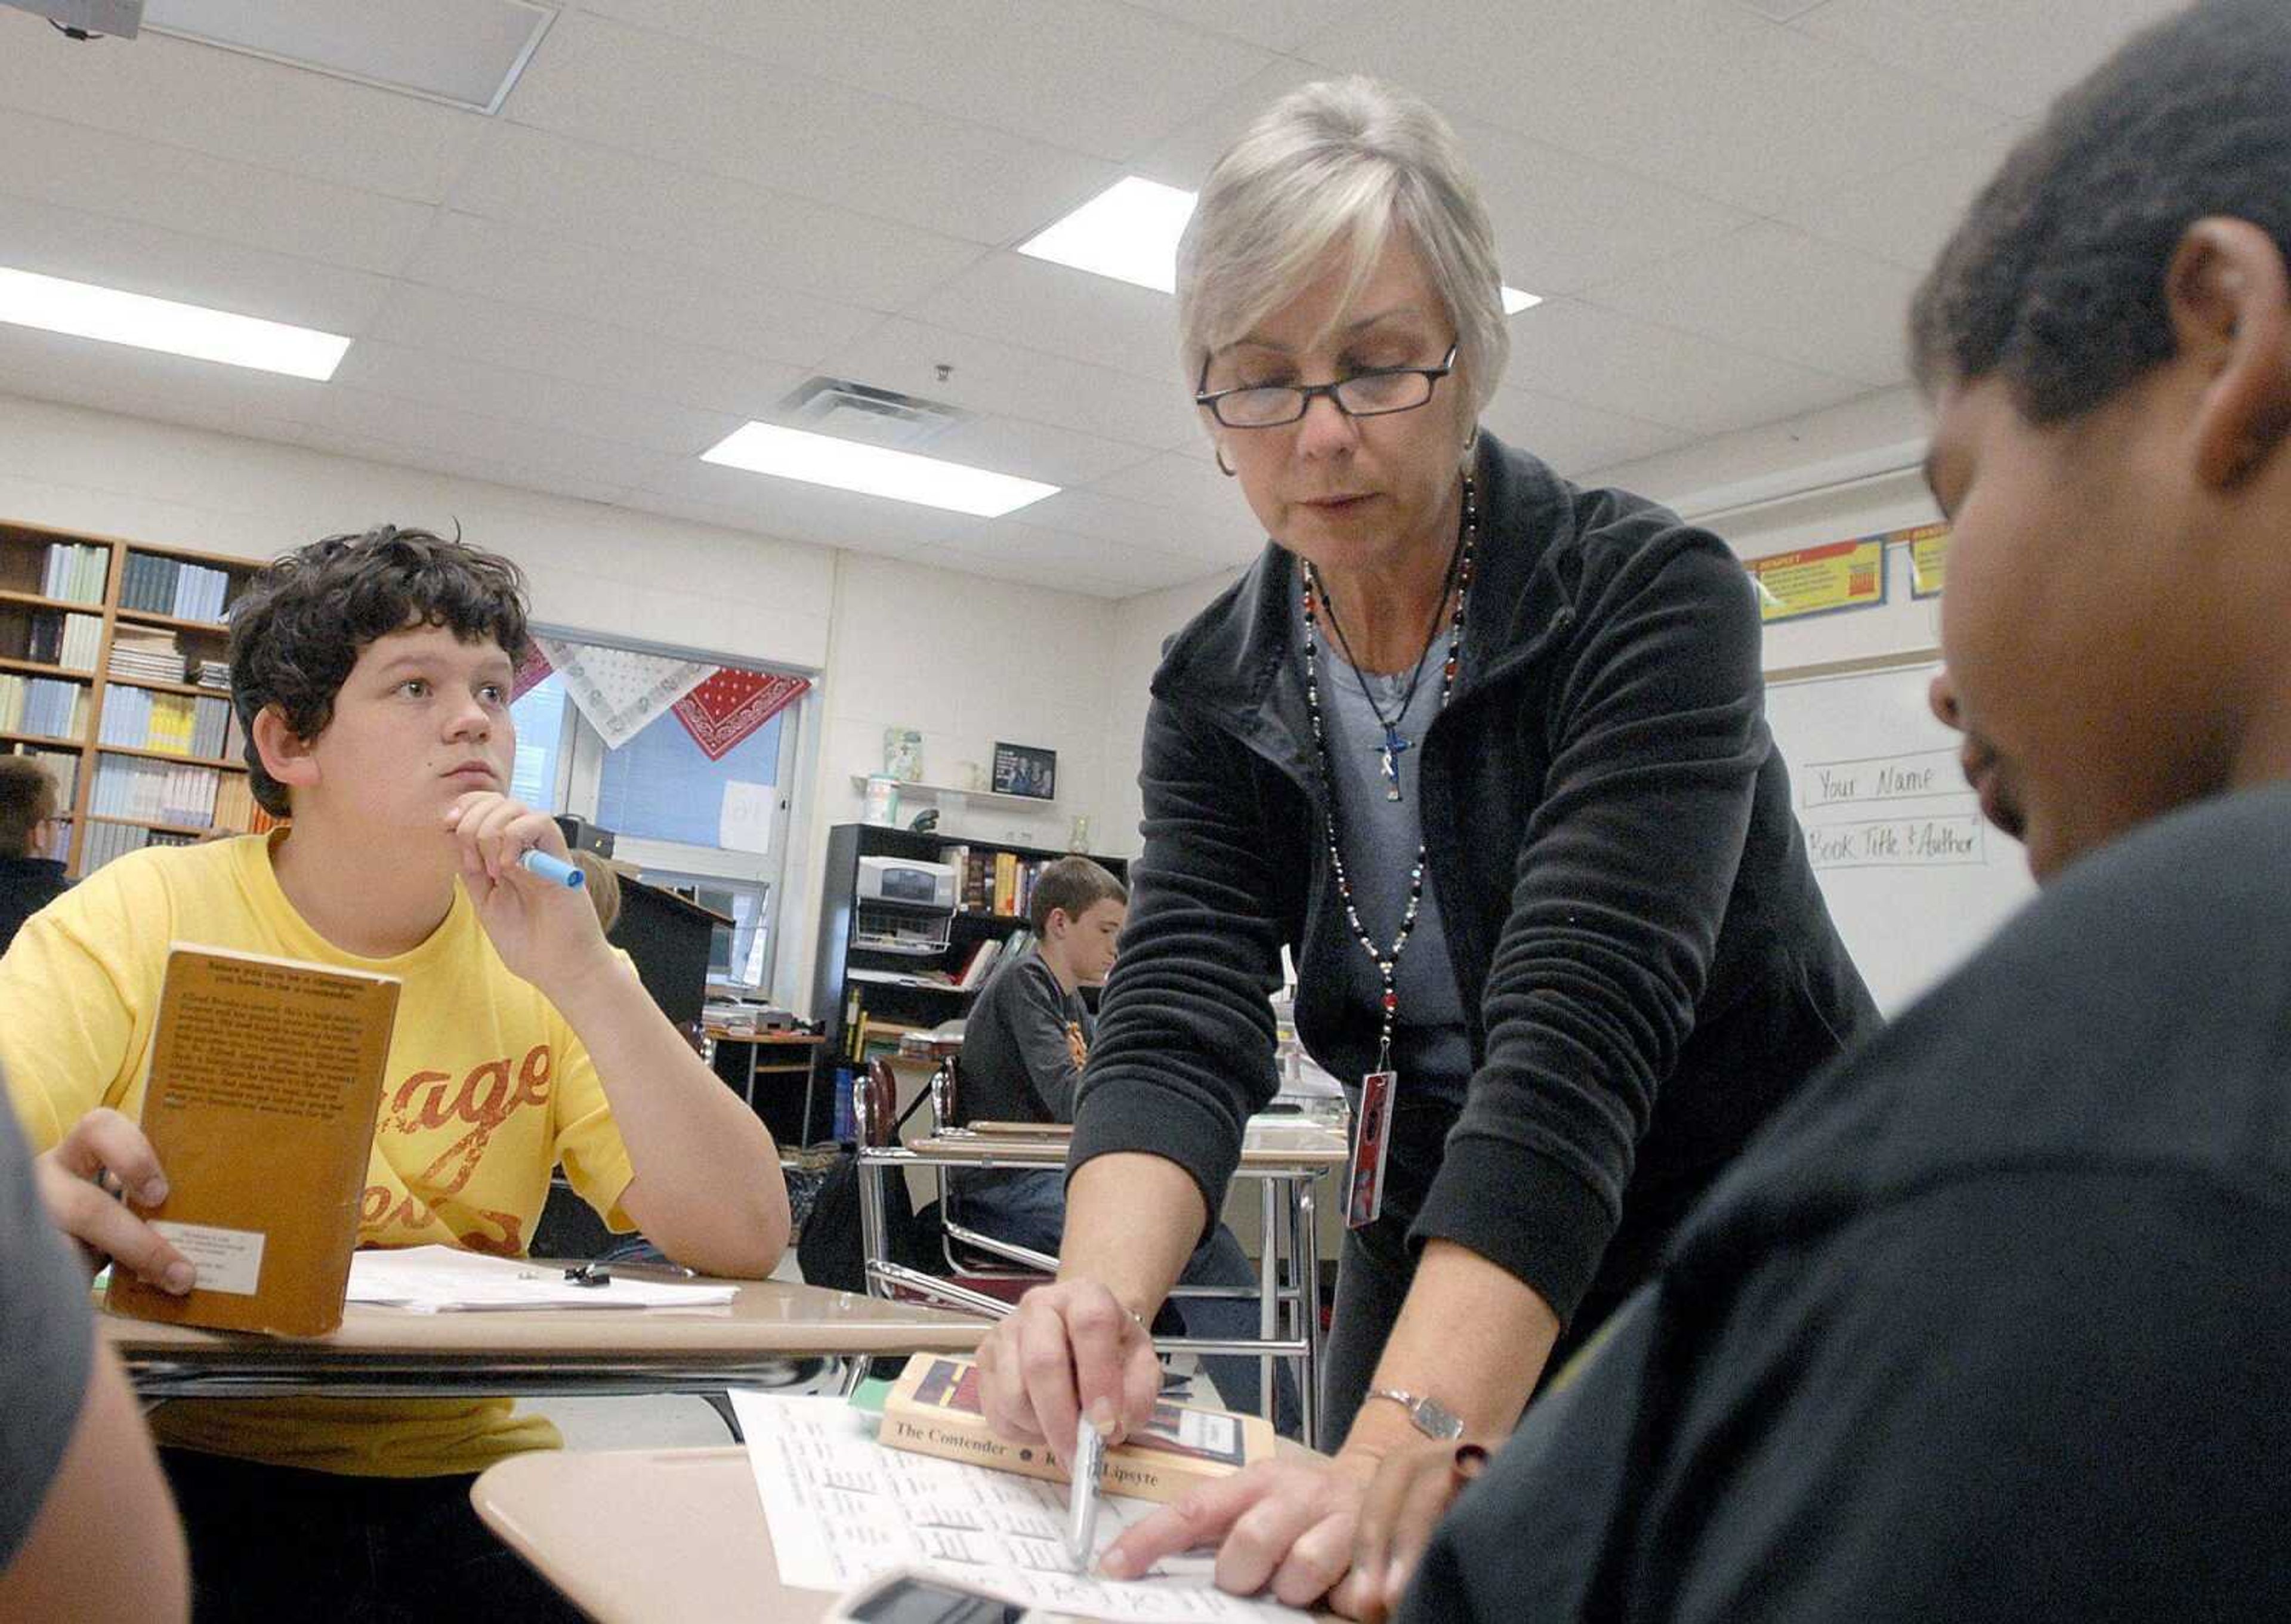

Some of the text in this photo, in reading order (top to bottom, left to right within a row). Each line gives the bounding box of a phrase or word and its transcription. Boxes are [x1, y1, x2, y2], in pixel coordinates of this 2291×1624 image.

[1820, 766, 1932, 799] Your Name
[1917, 823, 1974, 858] Author
[896, 1421, 1159, 1488] The Contender Lipsyte
